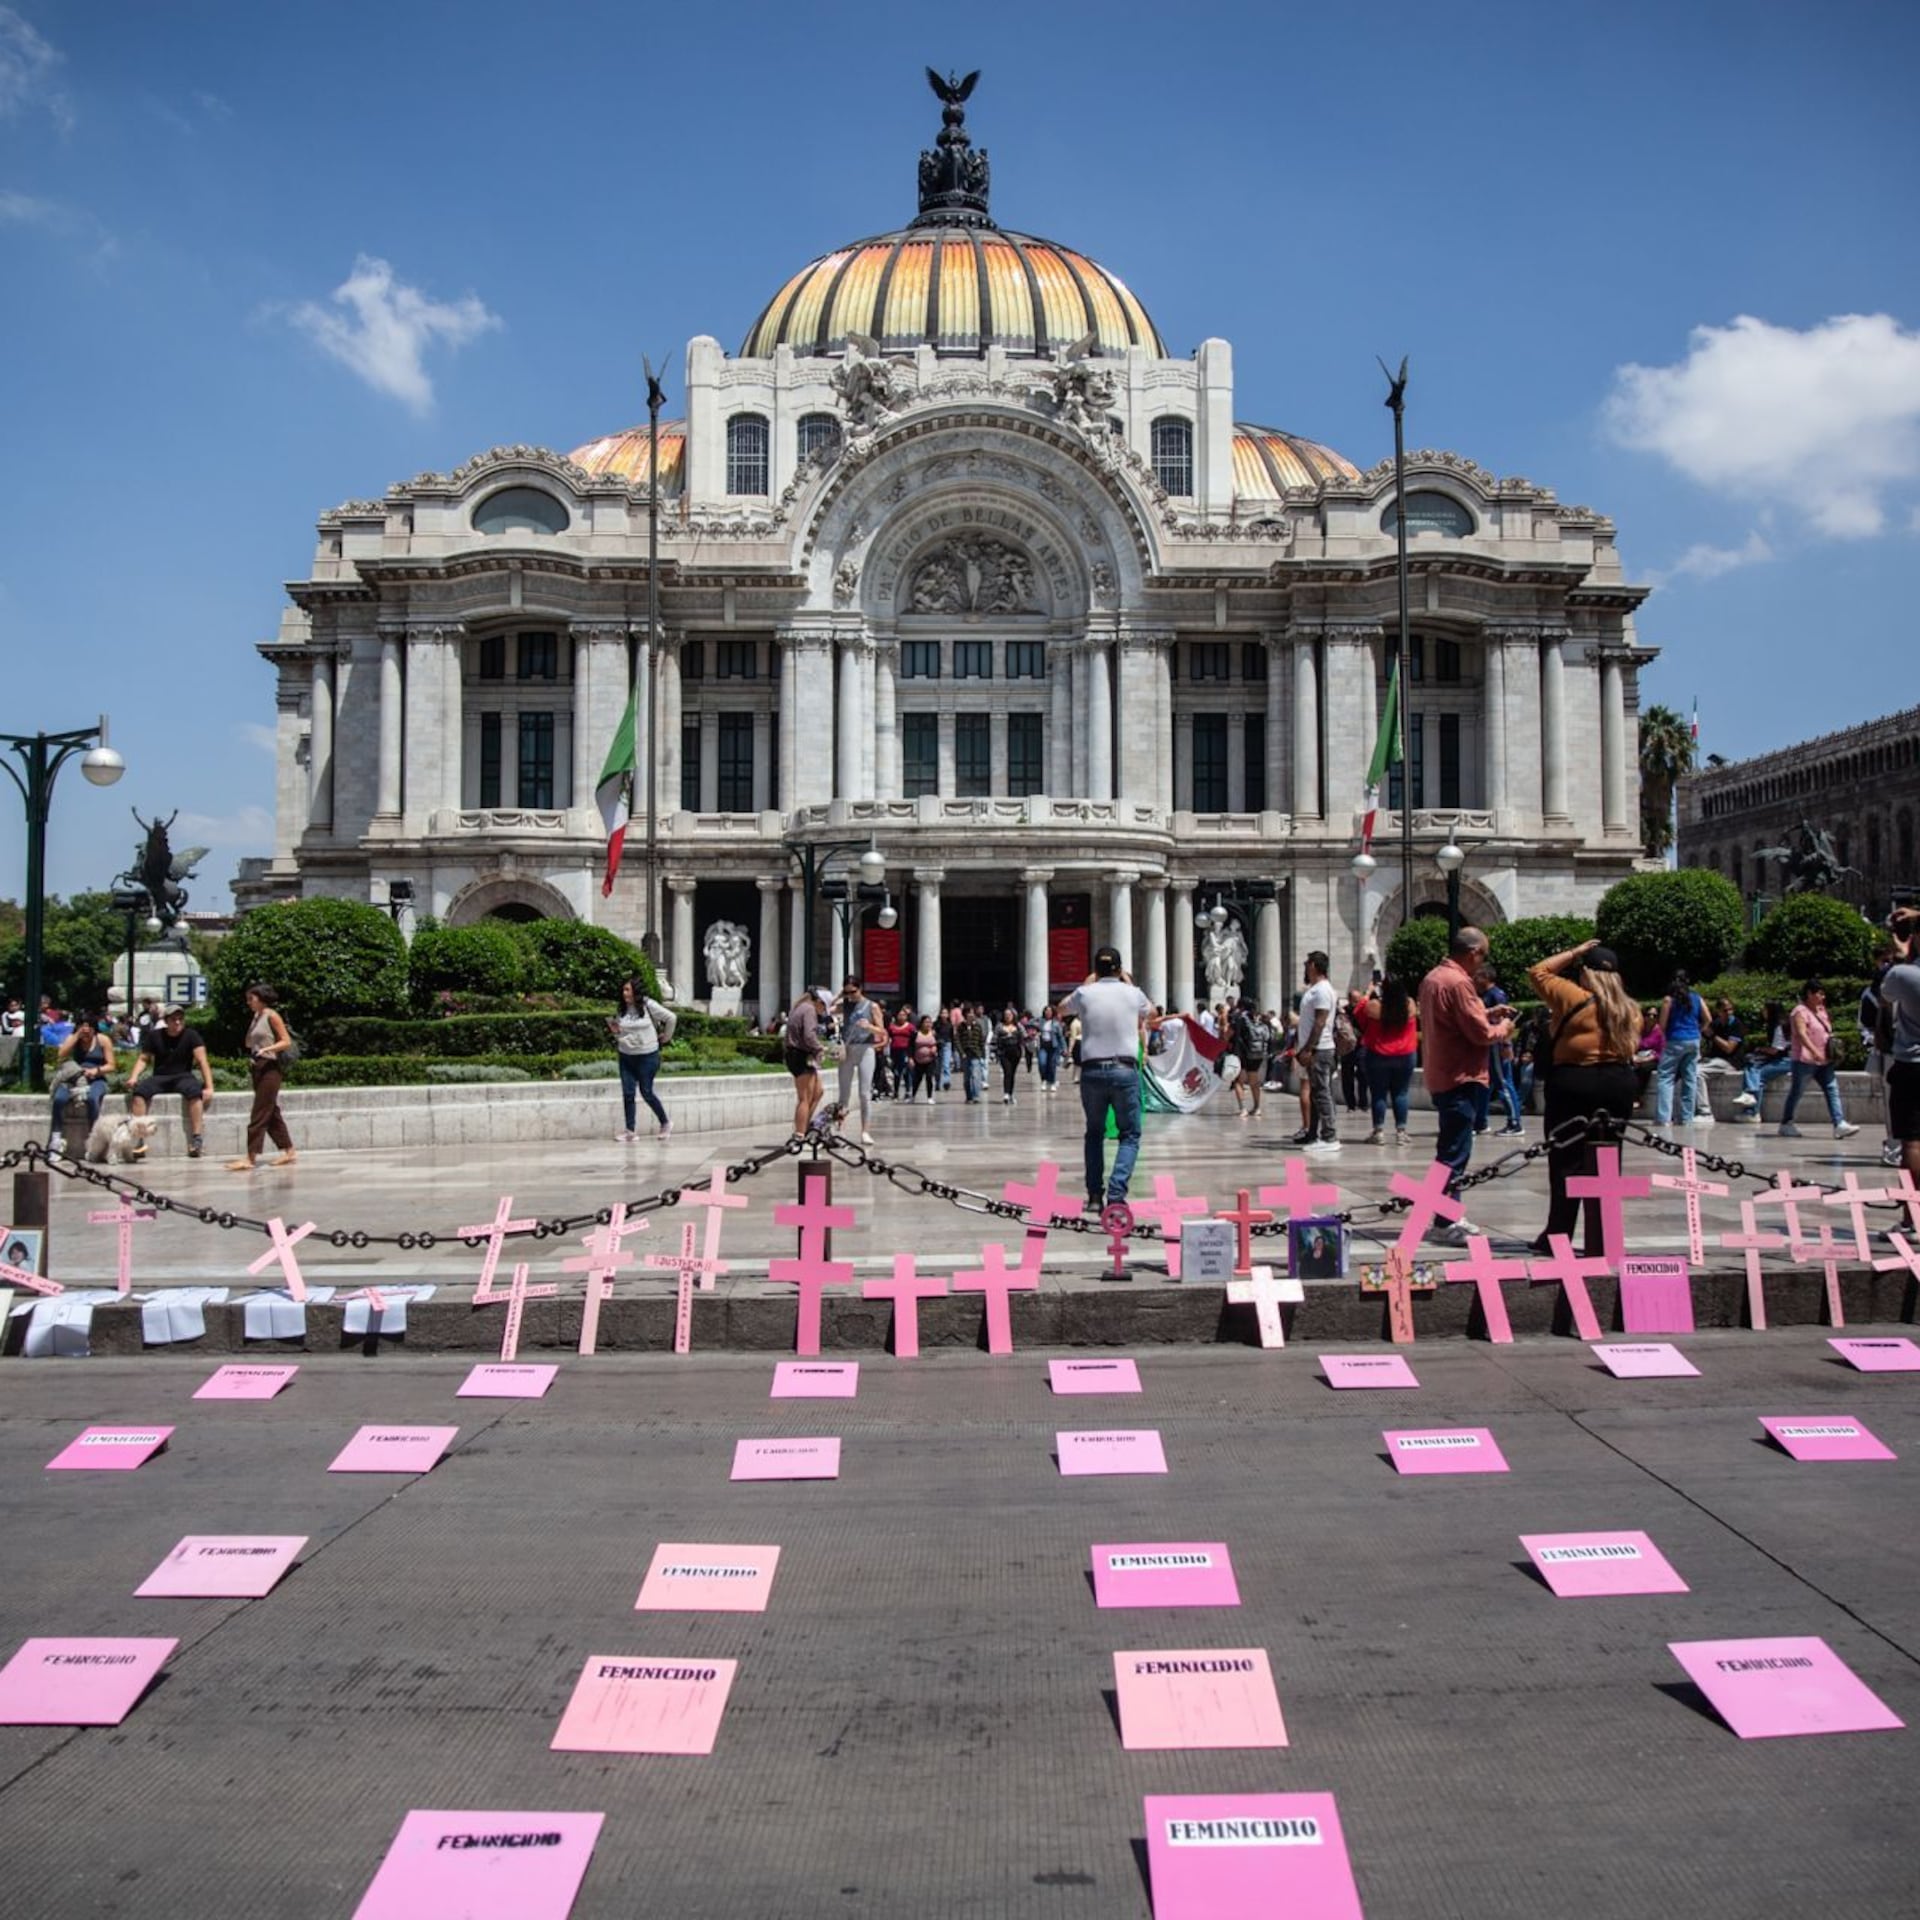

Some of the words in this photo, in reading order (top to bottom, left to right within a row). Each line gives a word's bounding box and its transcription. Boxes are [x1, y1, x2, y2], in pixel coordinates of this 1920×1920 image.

[879, 529, 922, 601] PALACIO
[928, 514, 952, 532] DE
[962, 507, 1038, 540] BELLAS
[1041, 545, 1070, 601] ARTES
[1626, 1263, 1680, 1274] FEMINICIDIO
[1541, 1546, 1637, 1559] FEMINICIDIO
[1111, 1555, 1208, 1567] FEMINICIDIO
[662, 1567, 758, 1577] FEMINICIDIO
[598, 1665, 717, 1681] FEMINICIDIO
[1135, 1659, 1254, 1675] FEMINICIDIO
[1169, 1820, 1317, 1840] FEMINICIDIO
